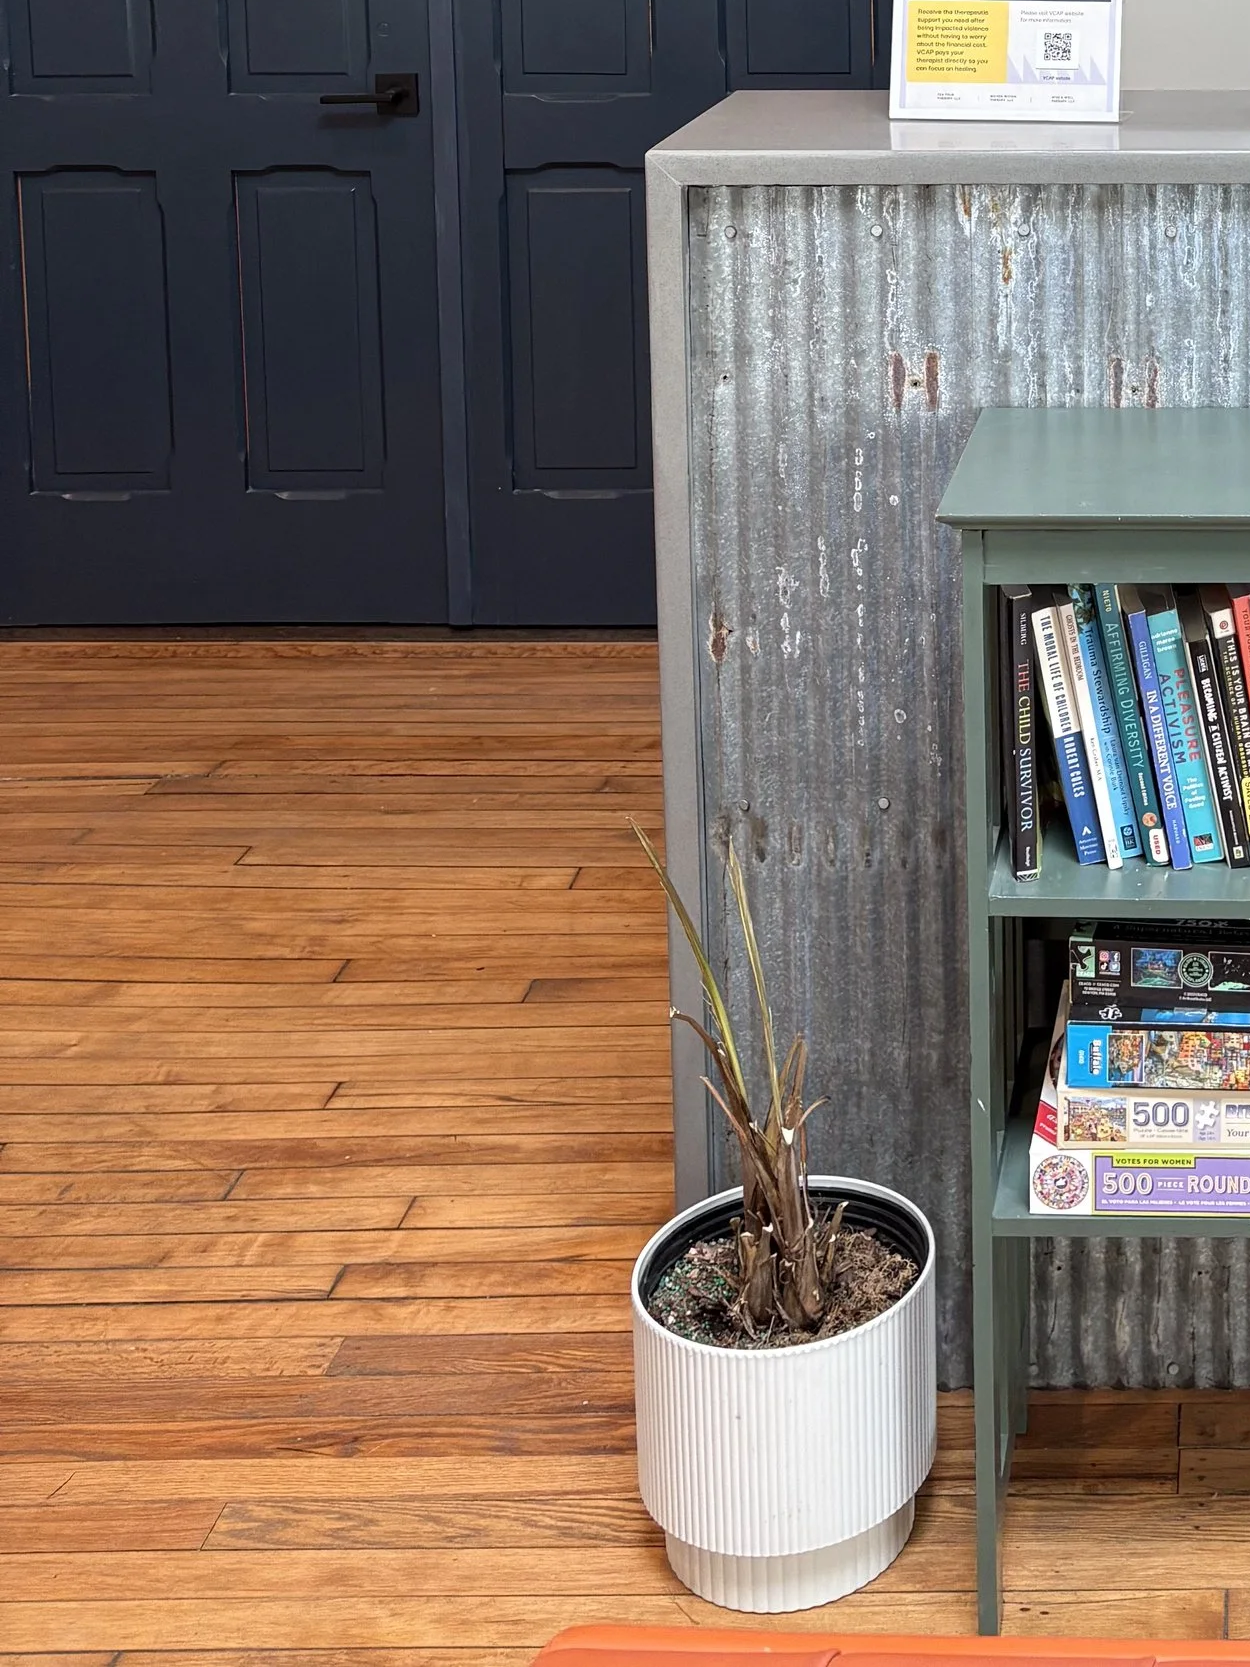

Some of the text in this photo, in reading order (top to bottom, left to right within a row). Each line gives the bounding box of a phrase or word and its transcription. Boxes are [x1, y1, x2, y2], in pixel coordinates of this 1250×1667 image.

[1151, 629, 1178, 639] adrienne
[1242, 609, 1250, 630] YOUR
[1066, 614, 1076, 634] GHOSTS
[1074, 656, 1084, 681] BEDROOM
[1157, 644, 1177, 653] brown
[1226, 638, 1237, 662] THIS
[1018, 659, 1030, 692] THE
[1084, 626, 1111, 734] Trauma Stewardship
[1102, 589, 1144, 768] NIETO AFFIRMING DIVERSITY
[1232, 665, 1239, 676] IS
[1040, 615, 1086, 798] THE MORAL LIFE OF CHILDREN ROBERT COLES
[1201, 678, 1217, 722] BECOMING
[1231, 697, 1236, 706] OF
[1234, 677, 1244, 705] YOUR
[1019, 696, 1031, 745] CHILD
[1159, 674, 1186, 764] ACTIVISM
[1174, 668, 1201, 762] PLEASURE
[1209, 724, 1220, 732] A
[1233, 716, 1241, 741] HUMAN
[1238, 706, 1250, 739] BRAIN
[1139, 642, 1180, 844] GILLIGAN IN A DIFFERENT VOICE HARVARD
[1211, 732, 1227, 765] CITIZEN
[1020, 748, 1033, 832] SURVIVOR
[1218, 767, 1233, 801] ACTIVIST
[1093, 1039, 1103, 1075] Buffalo
[1133, 1102, 1189, 1127] 500
[1227, 1129, 1249, 1137] Your
[1103, 1172, 1153, 1195] 500
